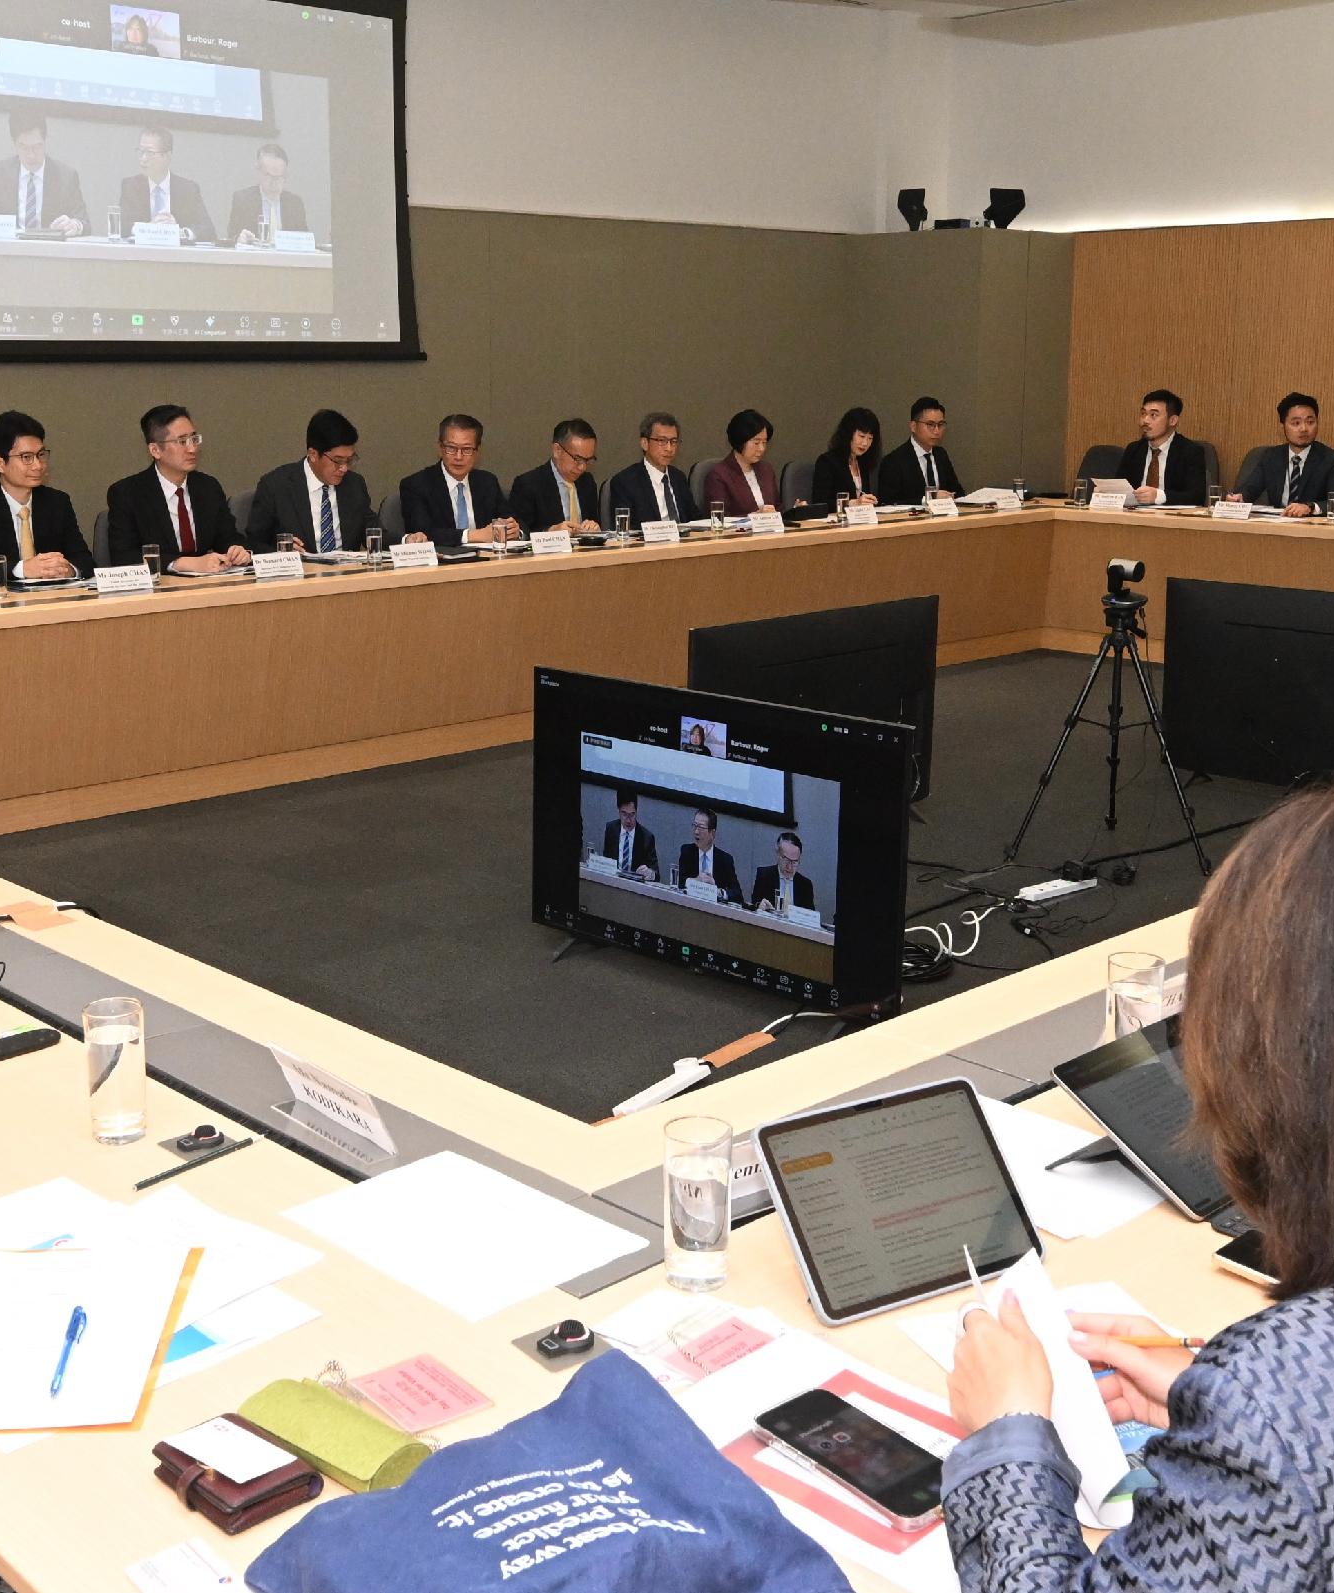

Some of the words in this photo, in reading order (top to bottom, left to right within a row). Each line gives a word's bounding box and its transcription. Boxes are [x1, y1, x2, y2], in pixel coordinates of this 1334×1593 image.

[130, 568, 149, 577] CHAN
[602, 1467, 634, 1491] is
[473, 1482, 565, 1519] create
[569, 1490, 640, 1510] your
[436, 1508, 476, 1531] it.
[472, 1500, 570, 1540] future
[500, 1504, 615, 1554] predict
[563, 1521, 640, 1550] best
[499, 1544, 566, 1581] way
